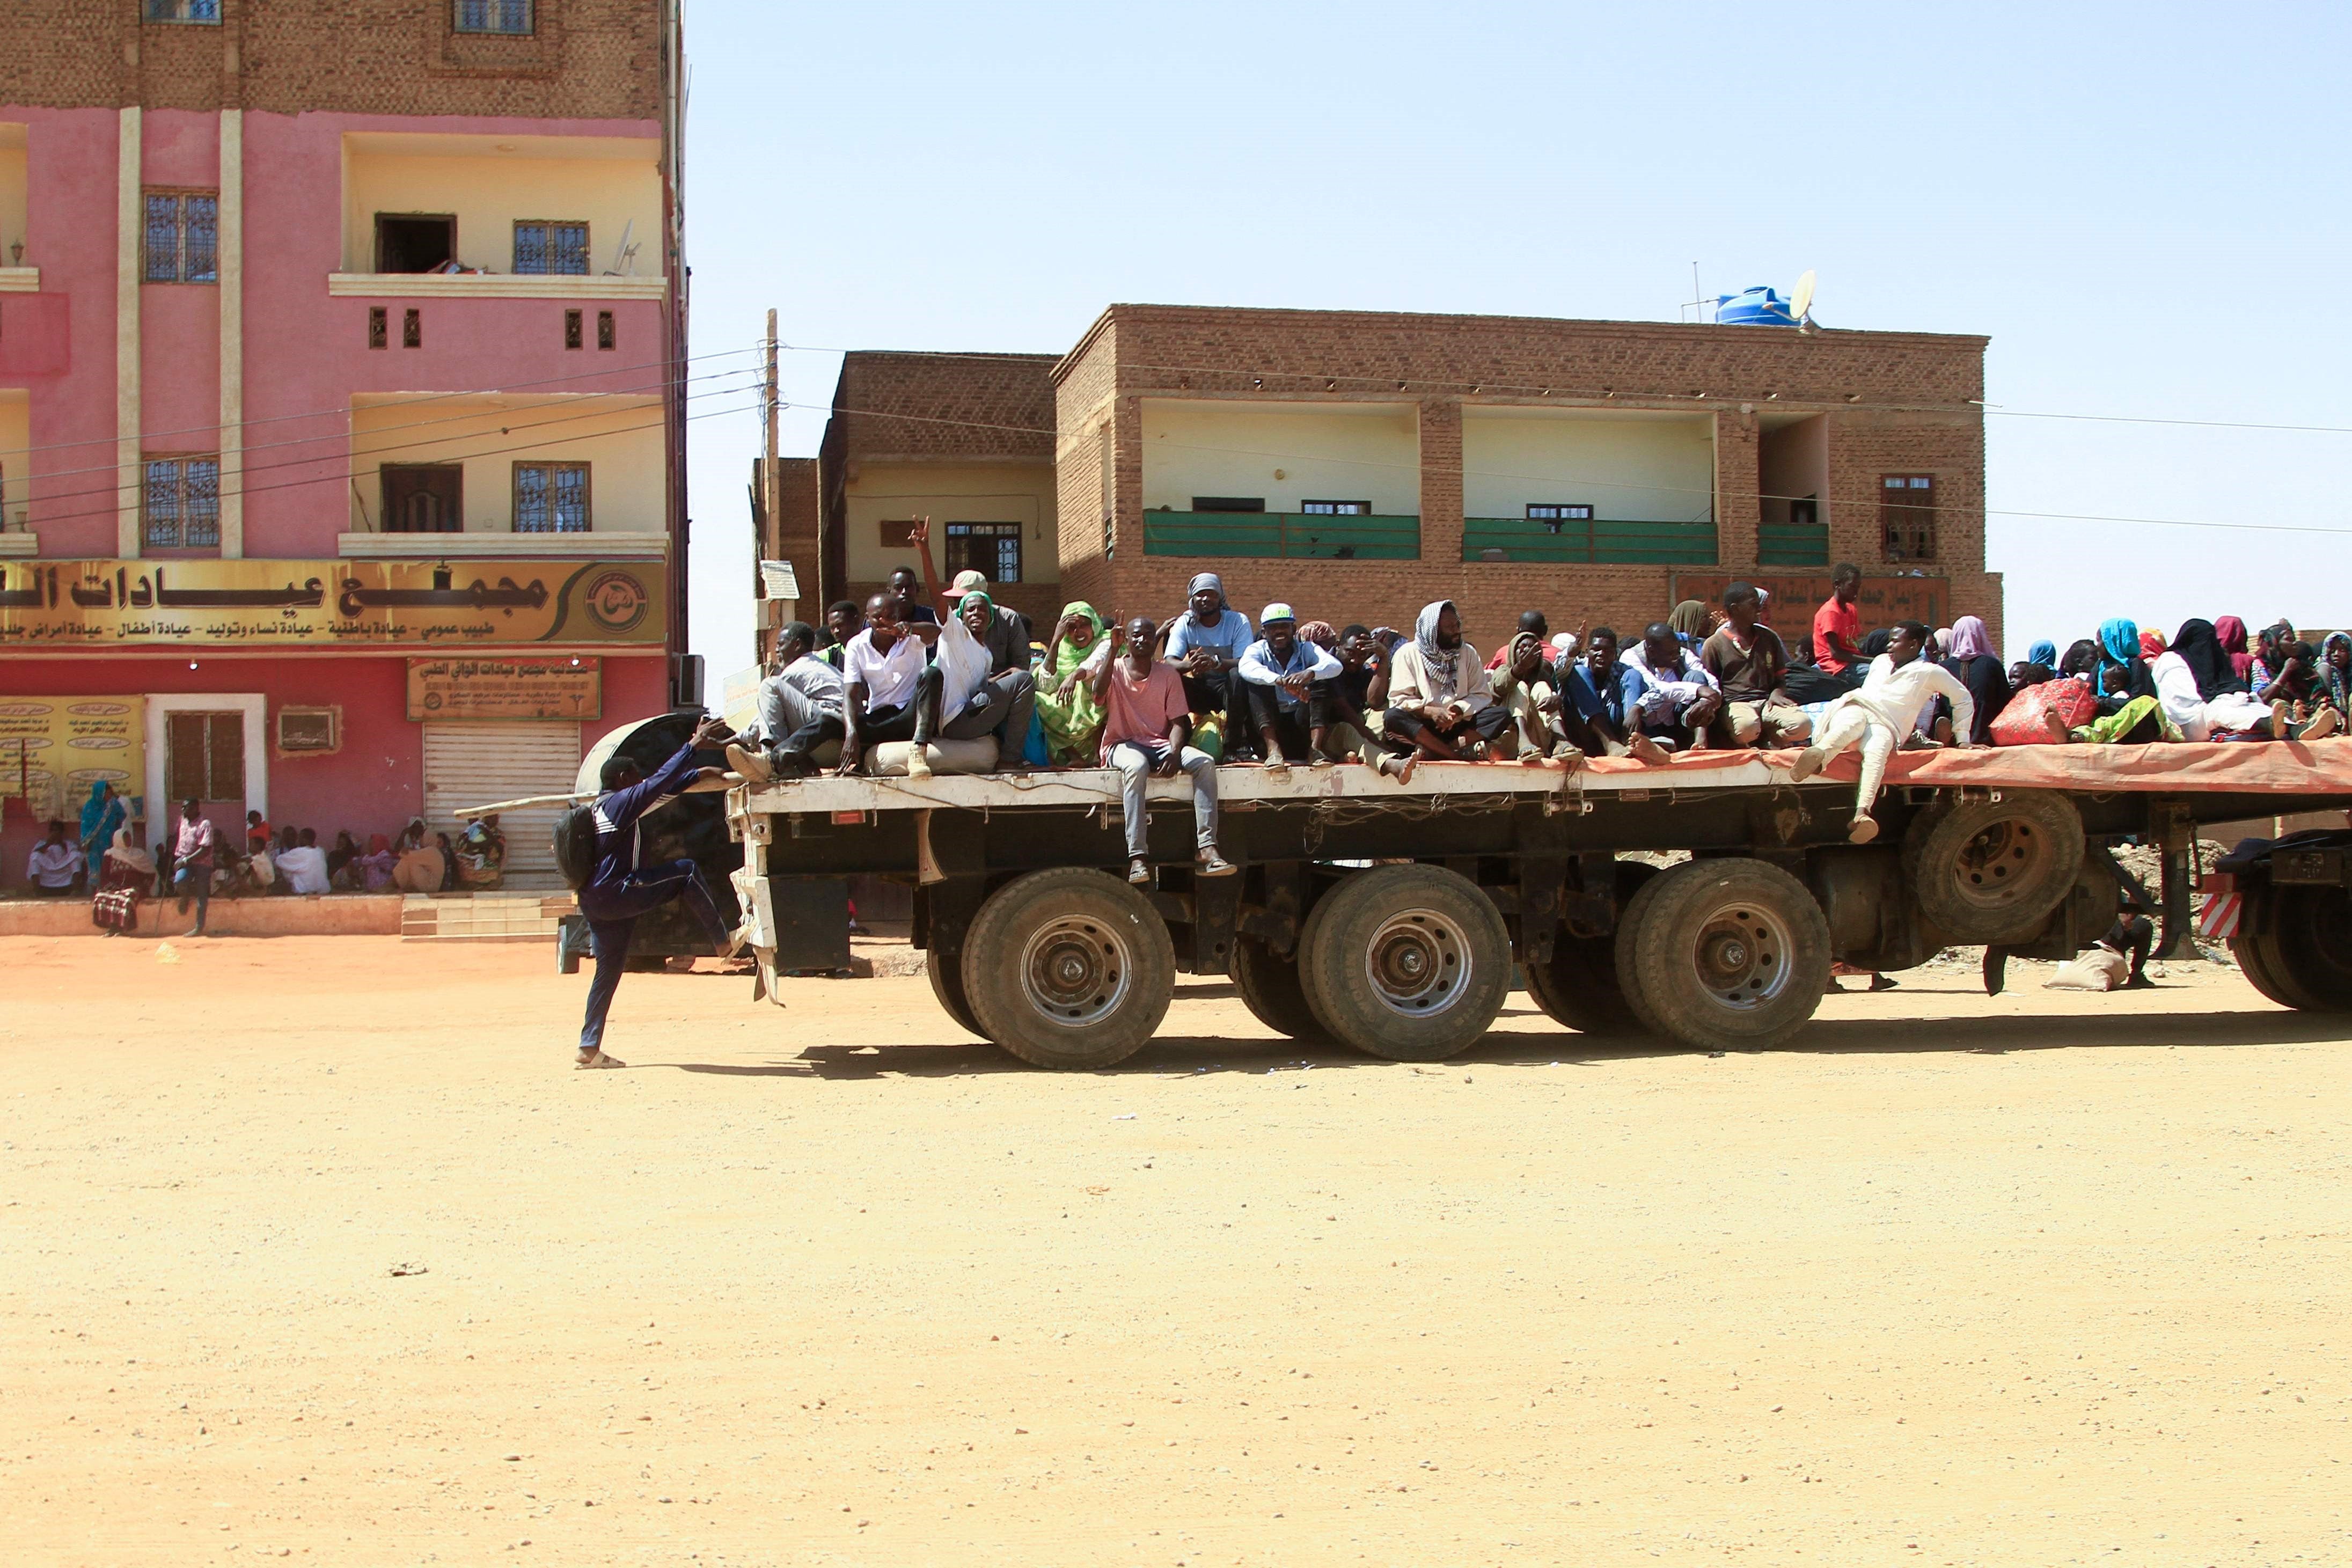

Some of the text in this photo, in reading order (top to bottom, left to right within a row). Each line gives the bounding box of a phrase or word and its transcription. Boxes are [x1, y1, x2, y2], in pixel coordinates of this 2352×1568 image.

[70, 566, 325, 618] عيادات
[339, 576, 549, 618] مجمع
[30, 622, 67, 639] أمراض
[68, 622, 102, 639] عيادة
[117, 620, 155, 639] أطفال
[157, 622, 192, 639] عيادة
[206, 621, 247, 639] وتوليد
[249, 621, 279, 636] نساء
[280, 621, 313, 638] عيادة
[328, 620, 371, 638] باطنية
[373, 621, 407, 638] عيادة
[421, 624, 459, 640] عمومي
[460, 621, 494, 638] طبيب
